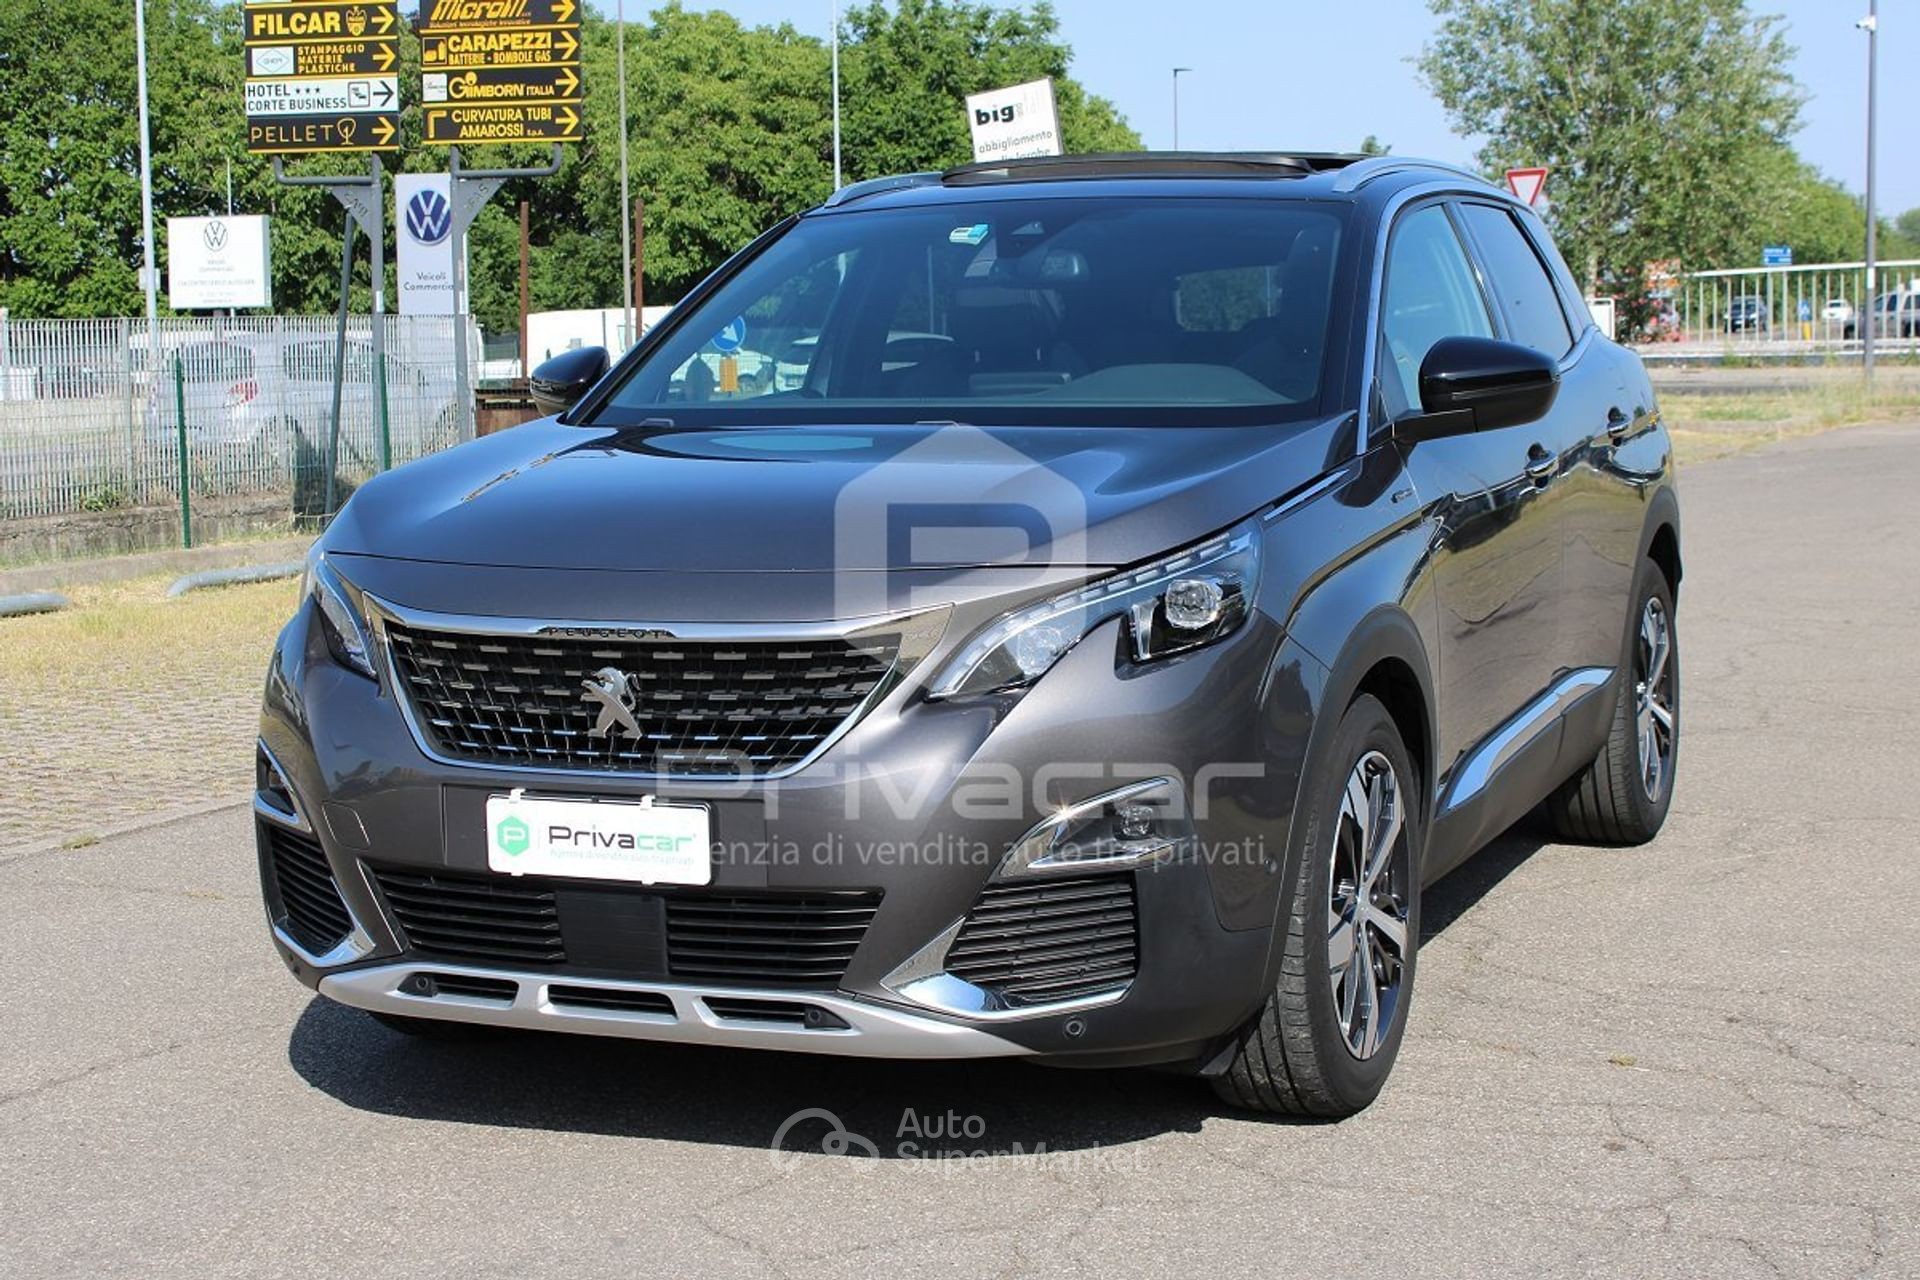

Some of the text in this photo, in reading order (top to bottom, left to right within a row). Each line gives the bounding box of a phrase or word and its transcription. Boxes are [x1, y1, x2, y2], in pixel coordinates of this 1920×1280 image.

[253, 11, 341, 36] FILCAR
[448, 32, 552, 52] CARAPEZZI
[297, 44, 365, 56] STAMPAGGIO
[449, 50, 552, 64] BATTERIE BOMBOLE GAS
[297, 54, 343, 64] MATERIE
[298, 63, 356, 74] PLASTICHE
[247, 84, 291, 97] HOTEL
[526, 85, 555, 97] ITALIA
[248, 97, 347, 112] CORTE BUSINESS
[451, 107, 552, 123] CURVATURA TUBI
[975, 104, 1015, 126] big
[251, 124, 334, 143] PELLET
[459, 123, 524, 138] AMAROSSI
[416, 271, 447, 281] Veicoli
[403, 281, 455, 291] Commercia
[549, 627, 660, 640] PEUGEOT
[549, 824, 693, 853] Privacar
